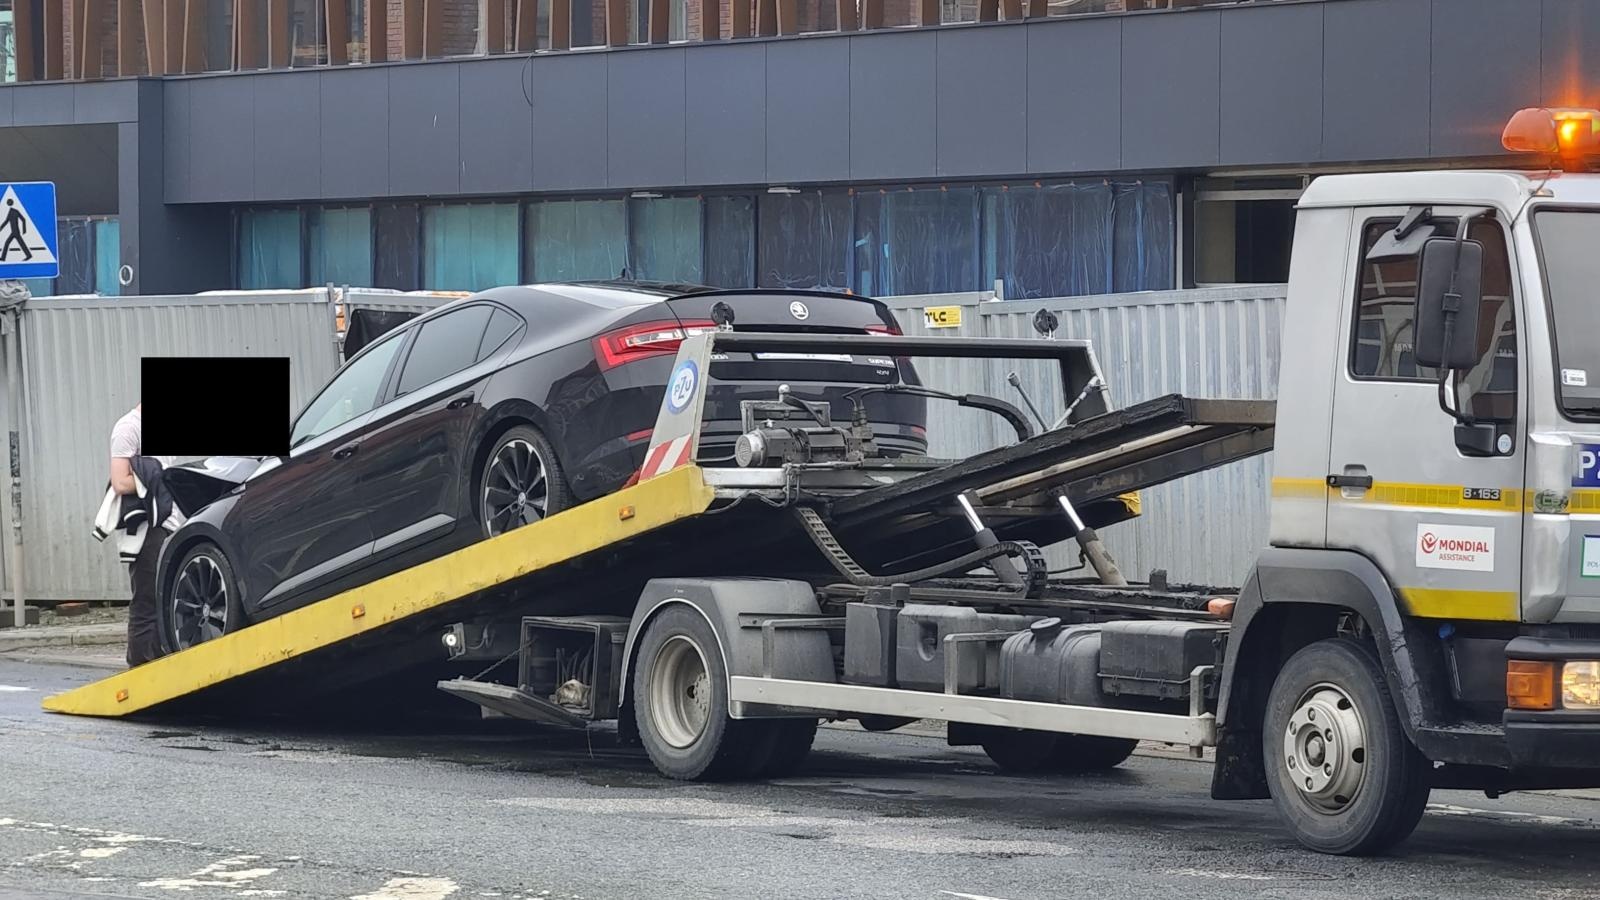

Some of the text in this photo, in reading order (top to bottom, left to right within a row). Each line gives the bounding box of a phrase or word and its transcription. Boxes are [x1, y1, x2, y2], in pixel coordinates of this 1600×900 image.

[673, 376, 692, 401] PZU
[1438, 539, 1490, 553] MONDIAL
[1438, 553, 1476, 562] ASSISTANCE
